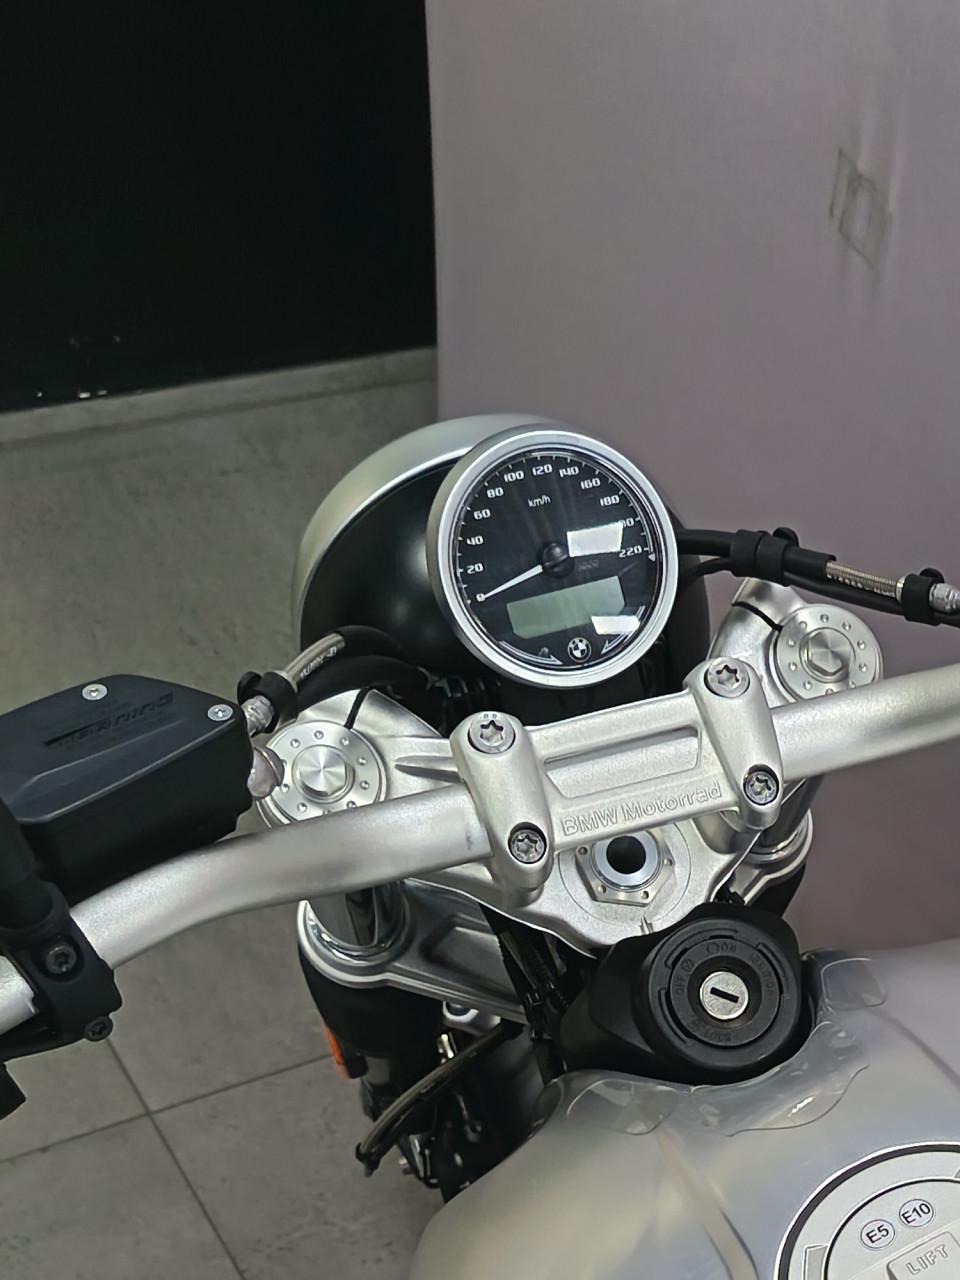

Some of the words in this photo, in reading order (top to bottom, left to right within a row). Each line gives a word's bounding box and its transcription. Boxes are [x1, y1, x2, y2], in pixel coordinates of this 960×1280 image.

[504, 470, 525, 483] 100
[532, 464, 553, 476] 120
[559, 465, 580, 478] 140
[580, 477, 601, 490] 160
[486, 487, 504, 499] 80
[528, 494, 552, 508] km/h
[599, 494, 620, 507] 180
[473, 508, 492, 520] 60
[466, 535, 484, 546] 40
[618, 545, 643, 558] 220
[466, 563, 484, 575] 20
[560, 805, 619, 838] BMW
[622, 780, 723, 822] Motorrad
[901, 1201, 932, 1225] E10
[865, 1224, 890, 1245] E5
[905, 1243, 950, 1276] LIFT
